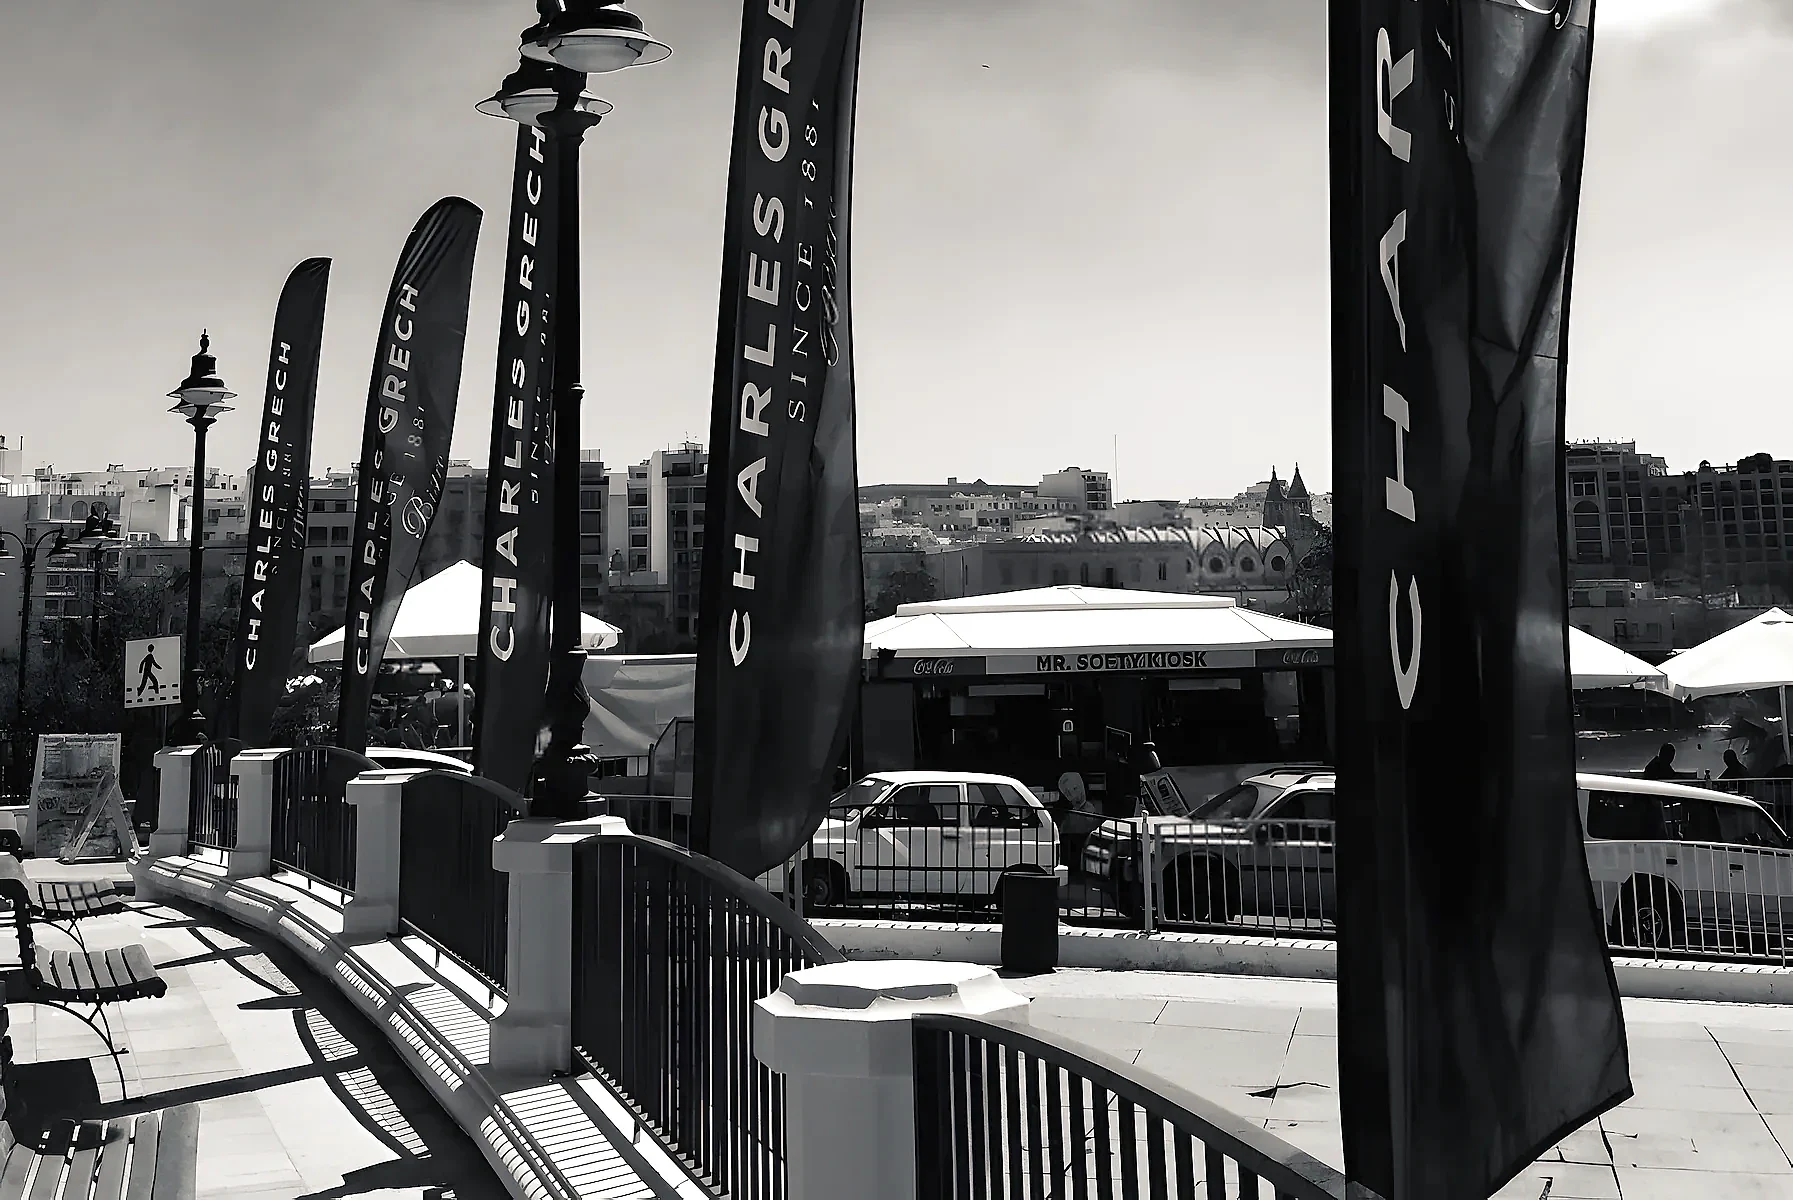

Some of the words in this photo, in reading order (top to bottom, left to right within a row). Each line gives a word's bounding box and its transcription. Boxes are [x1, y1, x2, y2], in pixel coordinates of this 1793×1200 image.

[378, 282, 421, 435] GRECH
[490, 356, 529, 662] CHARLES
[516, 126, 547, 337] GRECH
[729, 192, 785, 667] CHARLES
[787, 243, 814, 424] SINCE
[245, 485, 275, 672] CHARLES
[265, 339, 292, 473] GRECH
[1036, 654, 1071, 672] MR.
[1147, 650, 1208, 668] KIOSK
